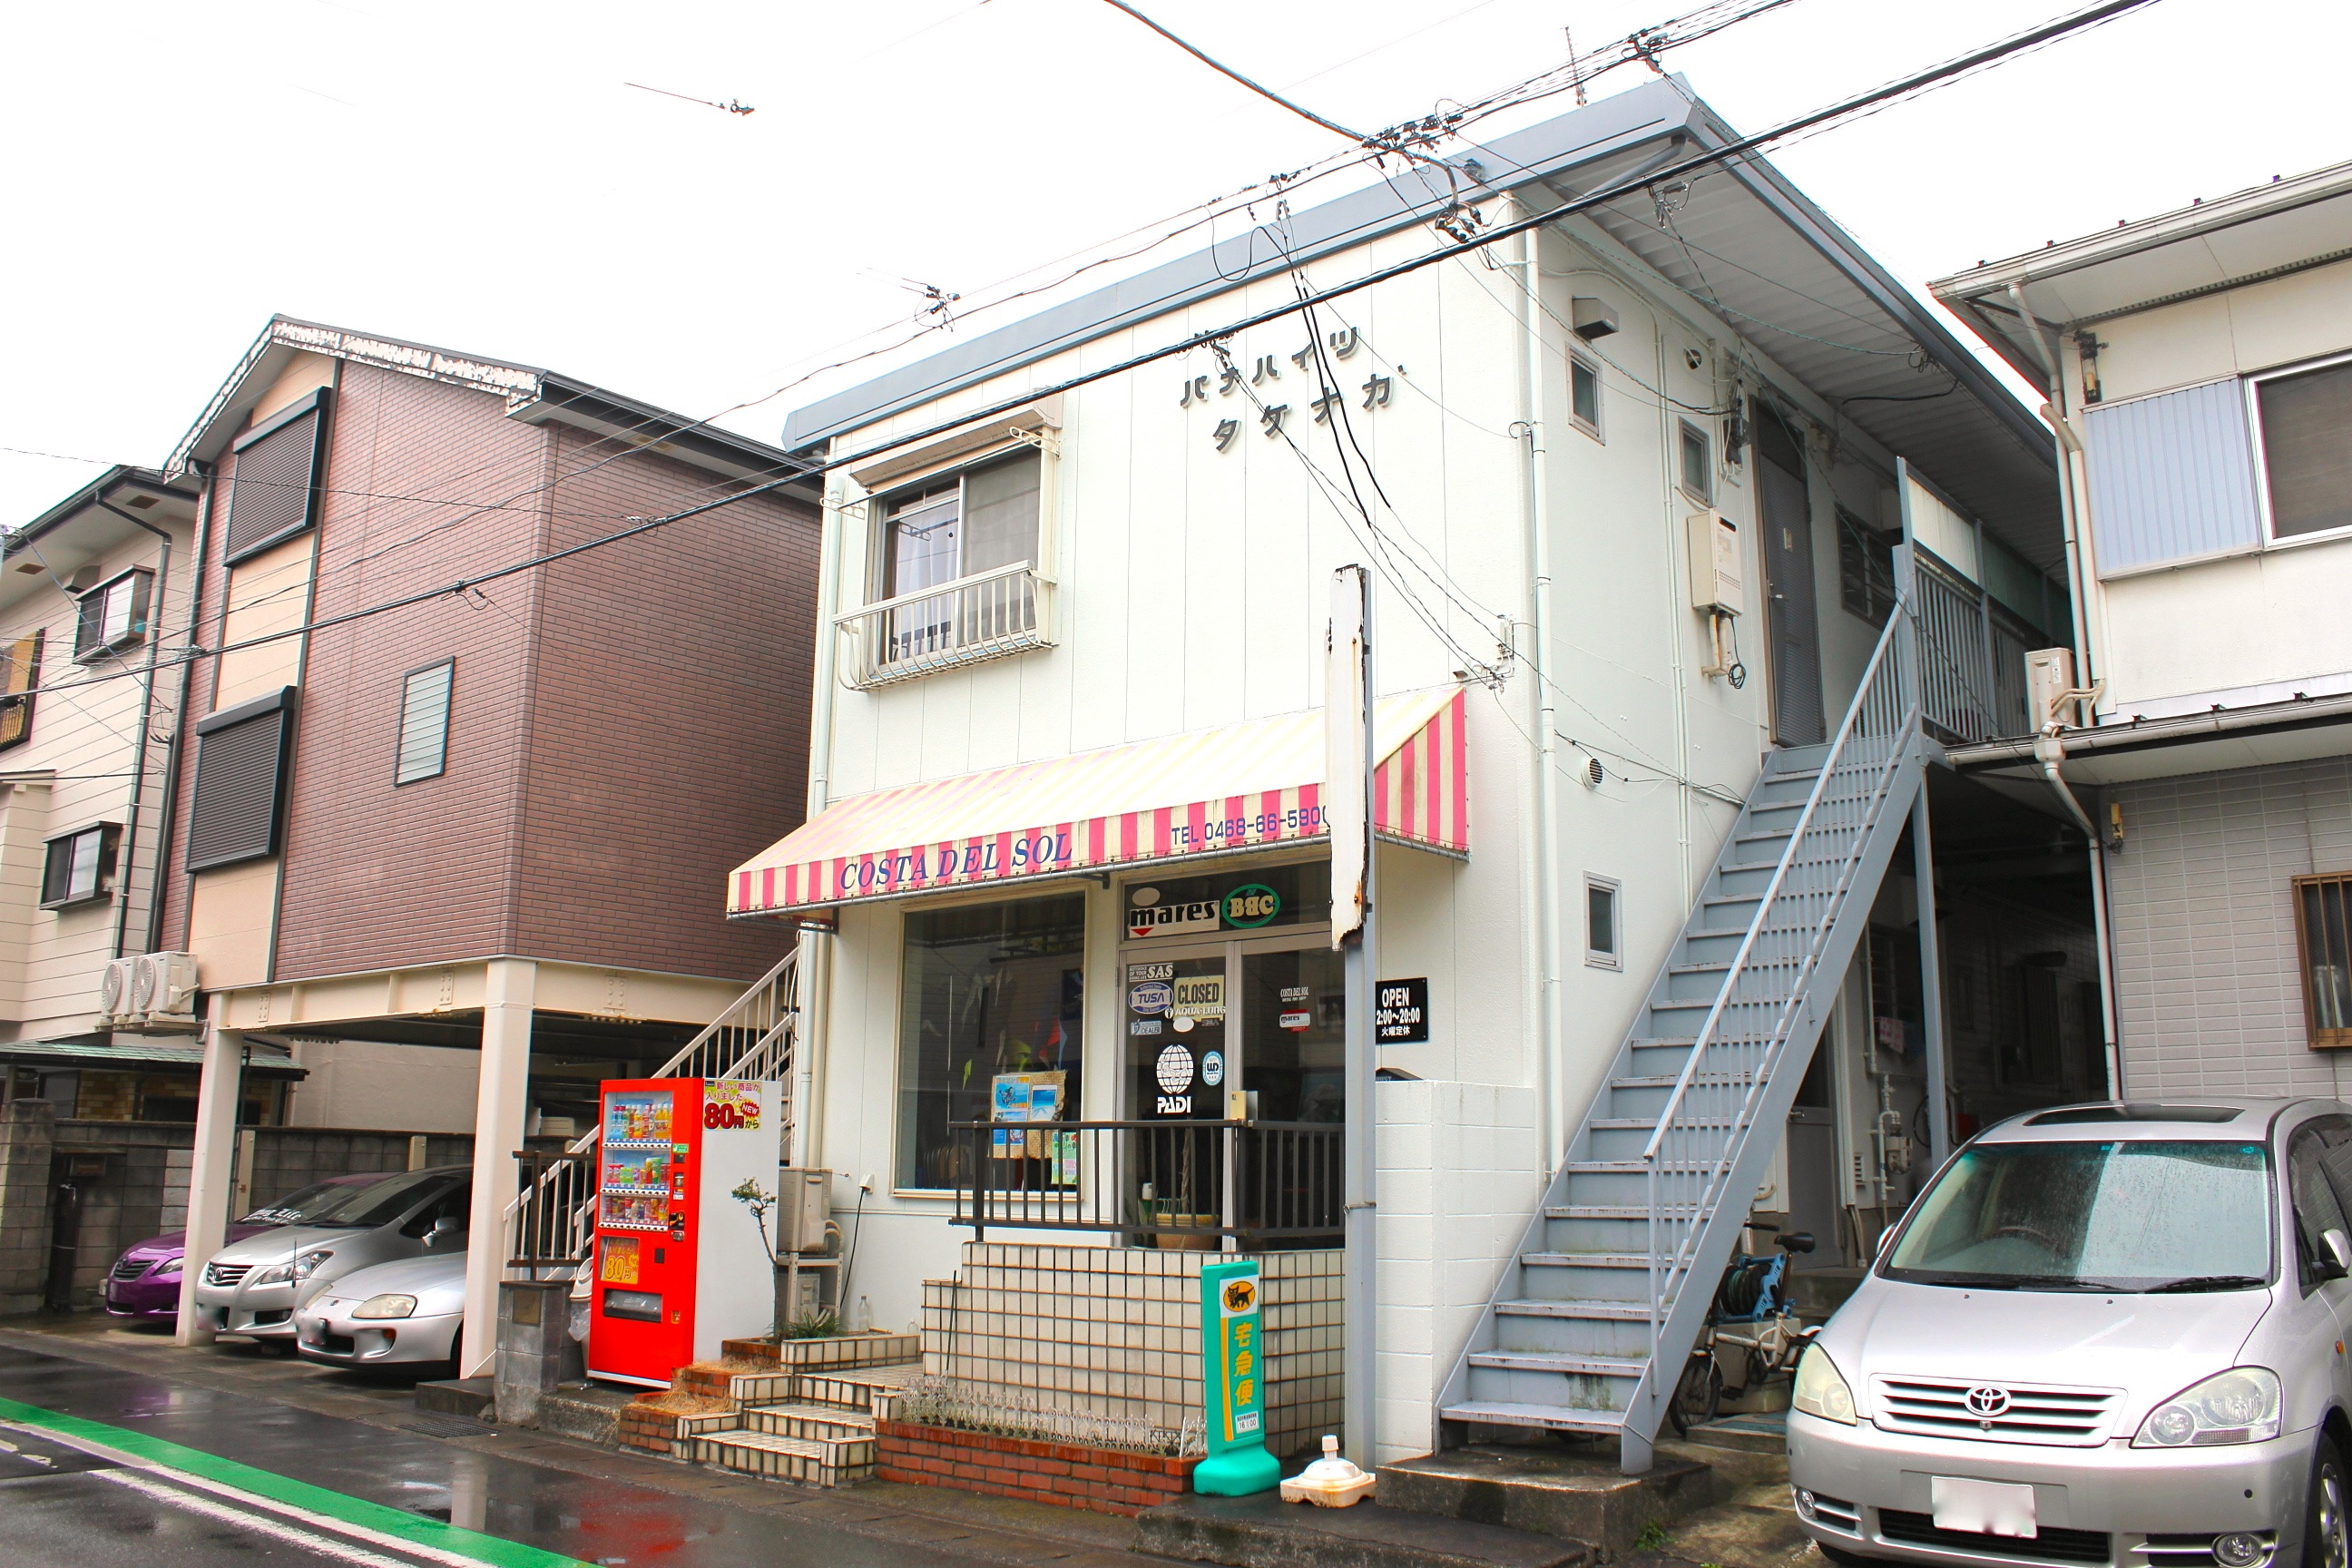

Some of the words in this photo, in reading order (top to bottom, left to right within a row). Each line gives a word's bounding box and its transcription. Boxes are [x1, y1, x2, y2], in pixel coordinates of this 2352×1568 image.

[1171, 826, 1199, 845] TEL
[840, 853, 927, 890] COSTA
[936, 843, 1001, 877] DEL
[1012, 833, 1073, 867] SOL
[1130, 901, 1216, 927] mares
[1147, 965, 1173, 979] SAS
[1138, 992, 1165, 1004] TUSA
[1177, 982, 1220, 1005] CLOSED
[1381, 987, 1410, 1007] OPEN
[1141, 1026, 1161, 1034] DEALER
[1381, 1025, 1411, 1036] 火曜定休
[716, 1082, 760, 1092] 新しい商品が
[741, 1103, 759, 1115] NEW
[1157, 1096, 1191, 1114] PADI
[1233, 1321, 1254, 1406] 宅急便
